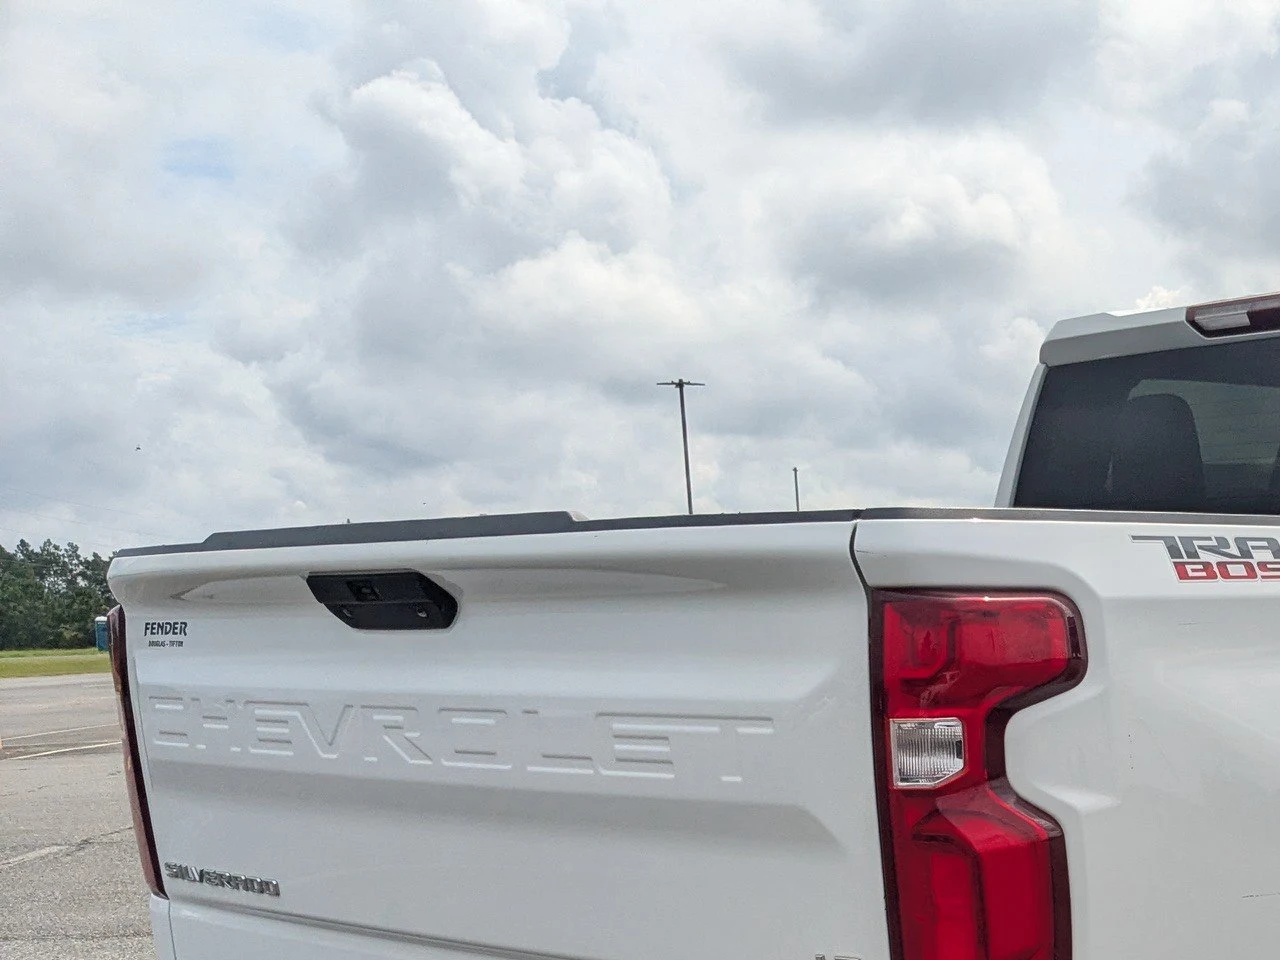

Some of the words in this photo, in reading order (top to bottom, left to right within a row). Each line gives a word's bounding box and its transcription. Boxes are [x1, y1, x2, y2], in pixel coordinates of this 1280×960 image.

[144, 621, 188, 637] FENDER
[149, 696, 774, 782] CHEVROLET
[164, 861, 281, 898] SILVERADO
